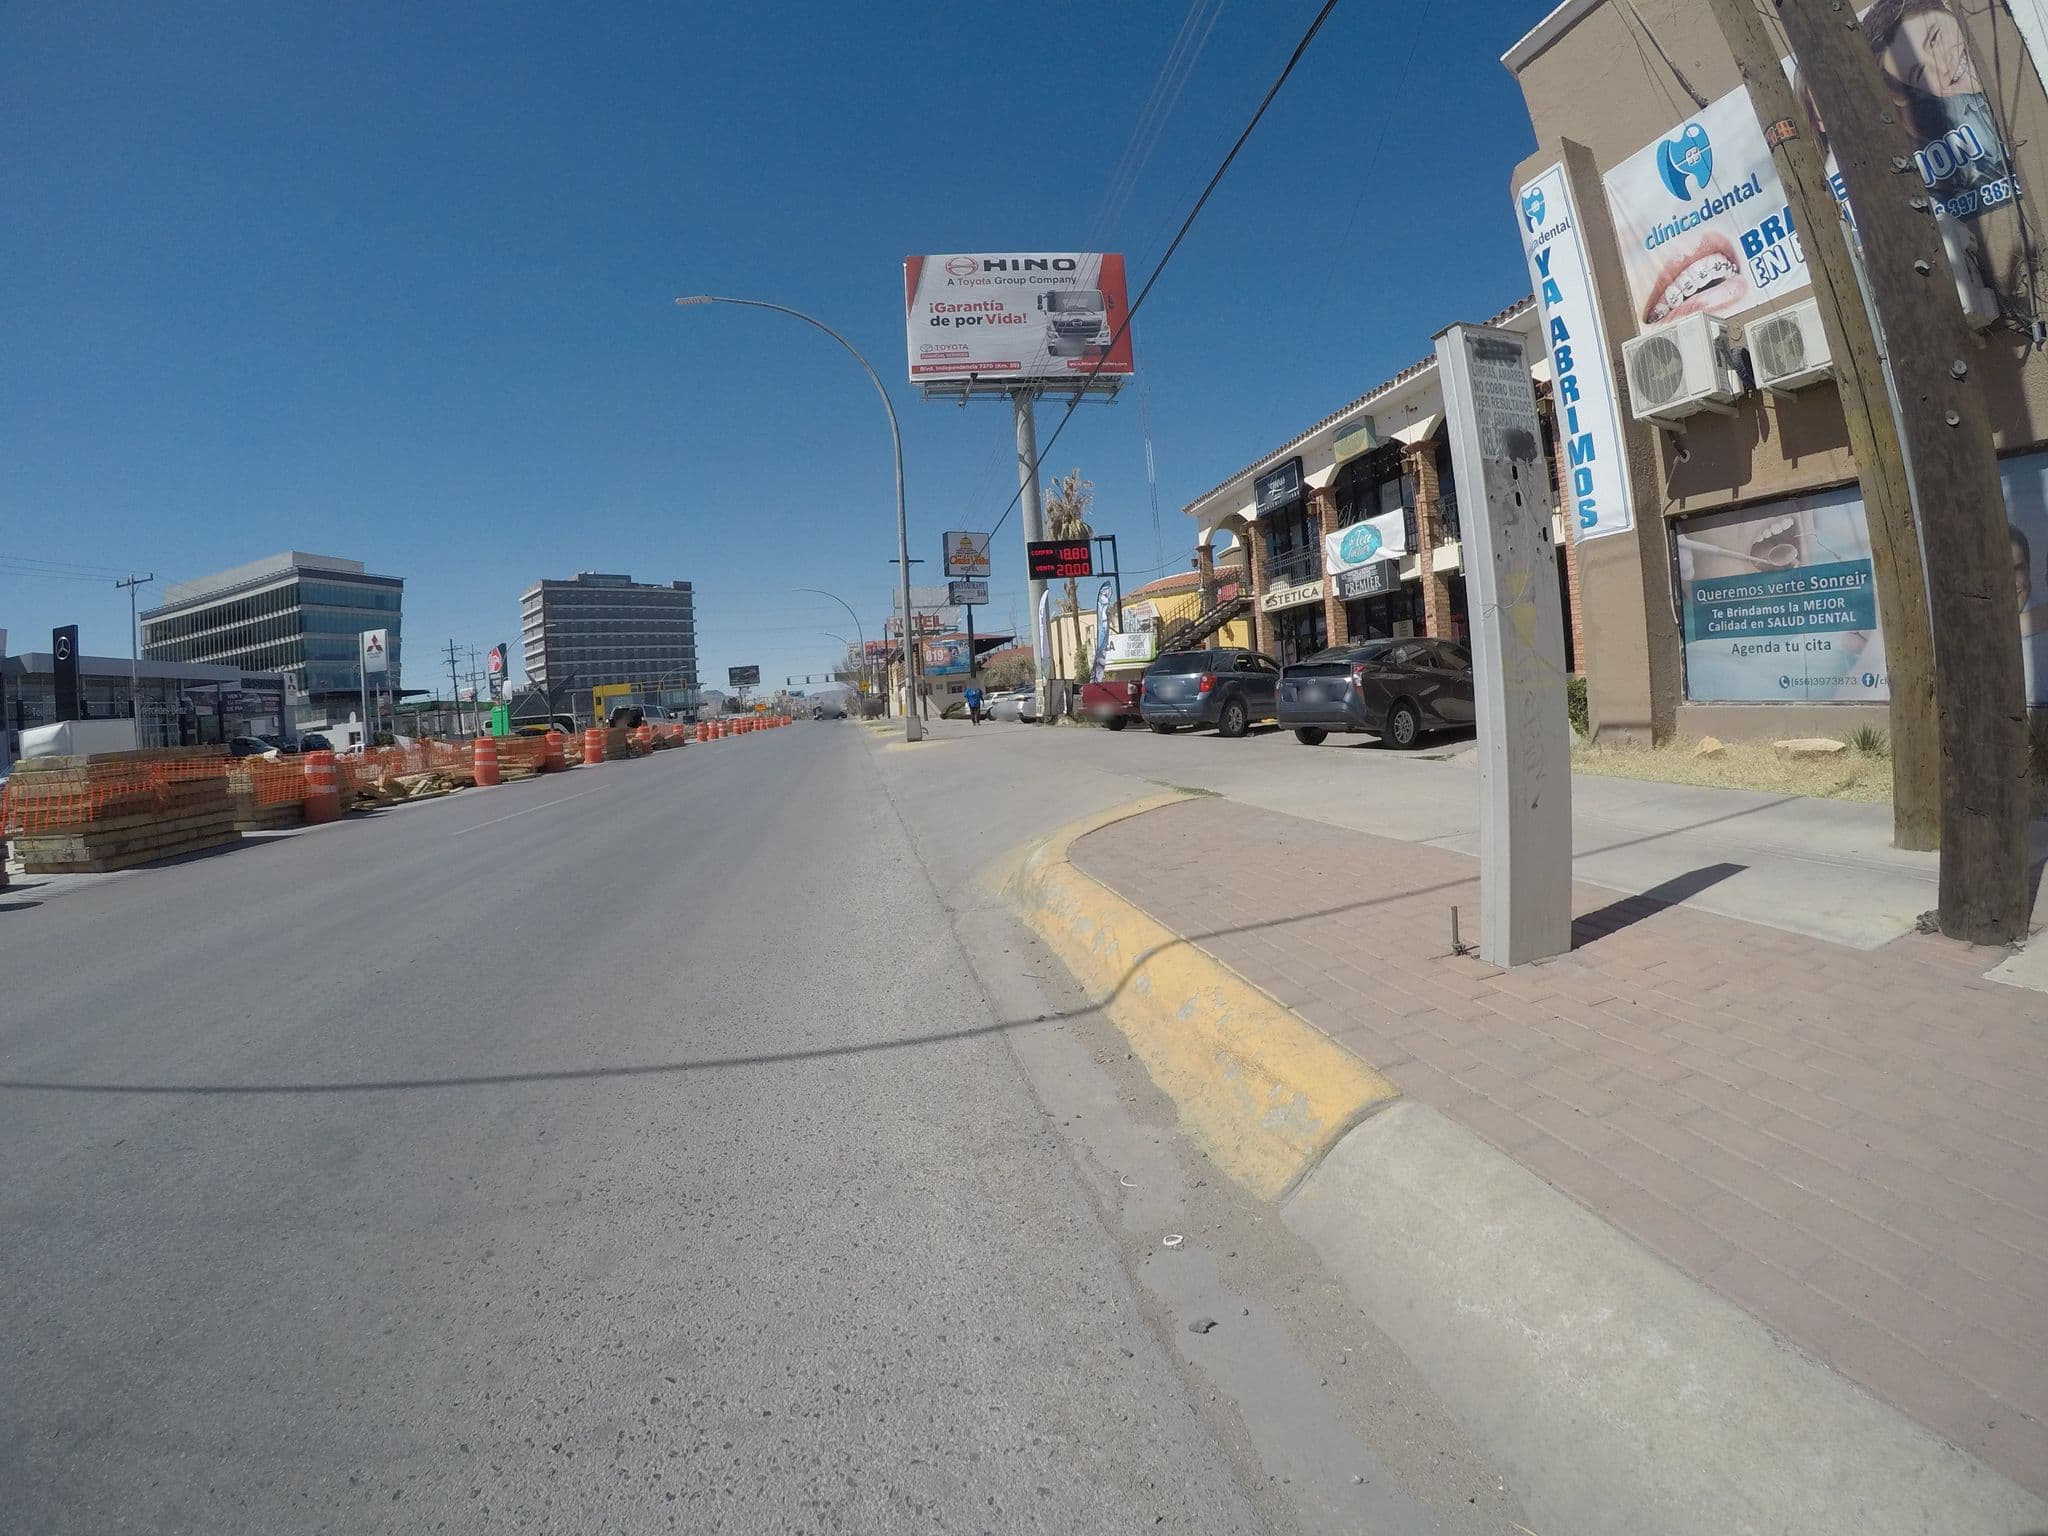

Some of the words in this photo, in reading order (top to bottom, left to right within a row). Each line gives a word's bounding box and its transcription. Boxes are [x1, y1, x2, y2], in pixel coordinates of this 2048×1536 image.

[1645, 173, 1762, 250] clínicadental
[1948, 190, 1978, 219] 397
[983, 258, 1076, 272] HINO
[1749, 245, 1791, 288] EN
[947, 278, 955, 286] A
[958, 277, 992, 287] Toyota
[994, 276, 1027, 286] Group
[1029, 275, 1077, 286] Company
[929, 299, 1005, 314] ¡Garantía
[930, 314, 950, 327] de
[955, 316, 983, 328] por
[985, 313, 1027, 325] Vida!
[1550, 315, 1599, 530] ABRIMOS
[1345, 575, 1382, 595] PREMIER
[1696, 584, 1763, 602] Queremos
[1768, 580, 1805, 594] verte
[1810, 571, 1868, 590] Sonreir
[1712, 609, 1724, 619] Te
[1726, 605, 1785, 618] Brindamos
[1789, 602, 1799, 612] la
[1803, 597, 1845, 611] MEJOR
[1708, 619, 1747, 632] Calidad
[1751, 619, 1764, 629] en
[1767, 615, 1805, 629] SALUD
[1809, 611, 1857, 625] DENTAL
[1731, 640, 1780, 657] Agenda
[1785, 639, 1799, 652] tu
[1805, 638, 1831, 652] cita
[1791, 675, 1858, 687] (656)3973873
